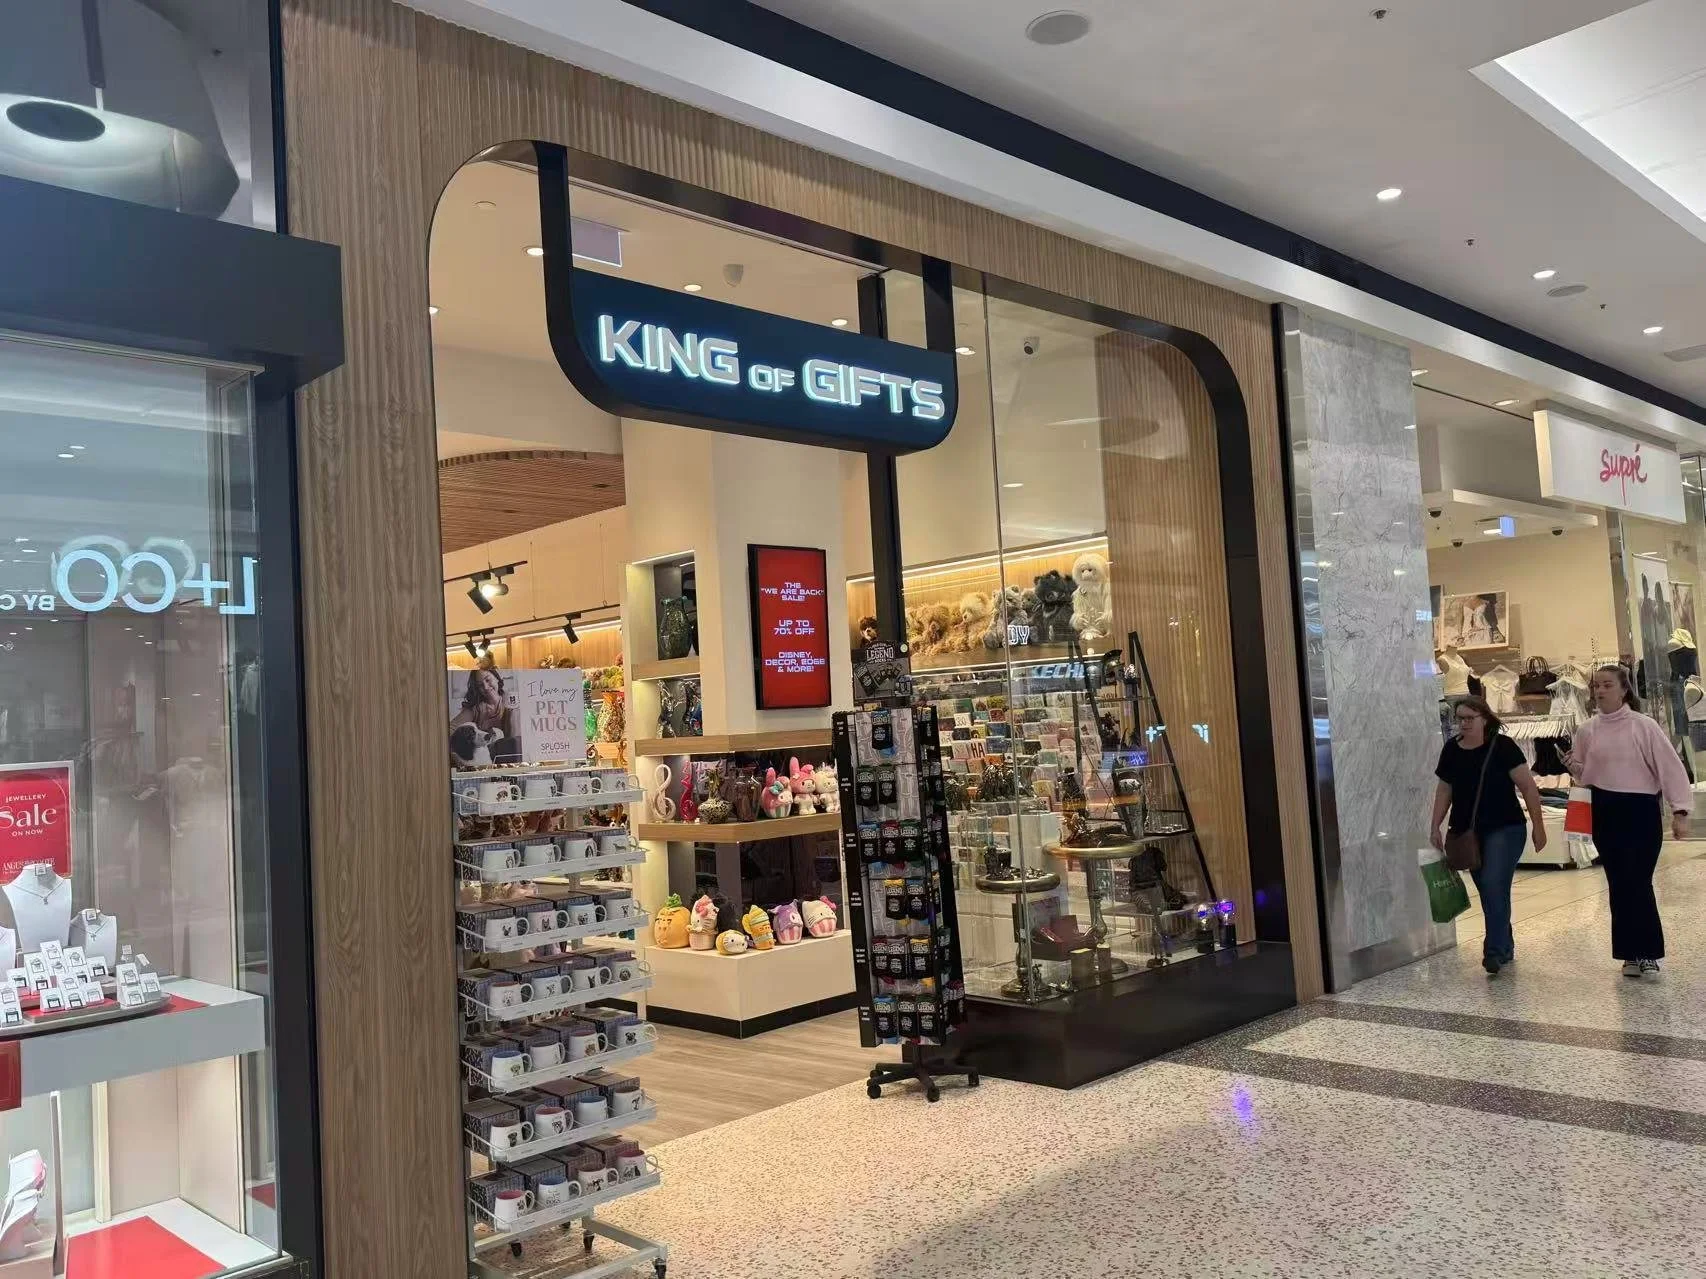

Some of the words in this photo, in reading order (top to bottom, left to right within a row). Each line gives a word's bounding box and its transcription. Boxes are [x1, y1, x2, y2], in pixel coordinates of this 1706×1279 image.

[598, 314, 740, 386] KING
[748, 364, 796, 393] OF
[802, 358, 945, 421] GIFTS
[774, 627, 792, 635] 70%
[795, 627, 815, 635] OFF
[778, 651, 813, 659] DISNEY,
[866, 646, 894, 662] LEGEND
[787, 665, 815, 673] MORE!
[527, 681, 537, 698] I
[539, 680, 559, 697] love
[561, 687, 578, 701] my
[536, 700, 568, 716] PET
[530, 717, 577, 732] MUGS
[540, 742, 570, 751] SPLOSH
[5, 794, 47, 803] JEWELLERY
[0, 803, 57, 829] Sale
